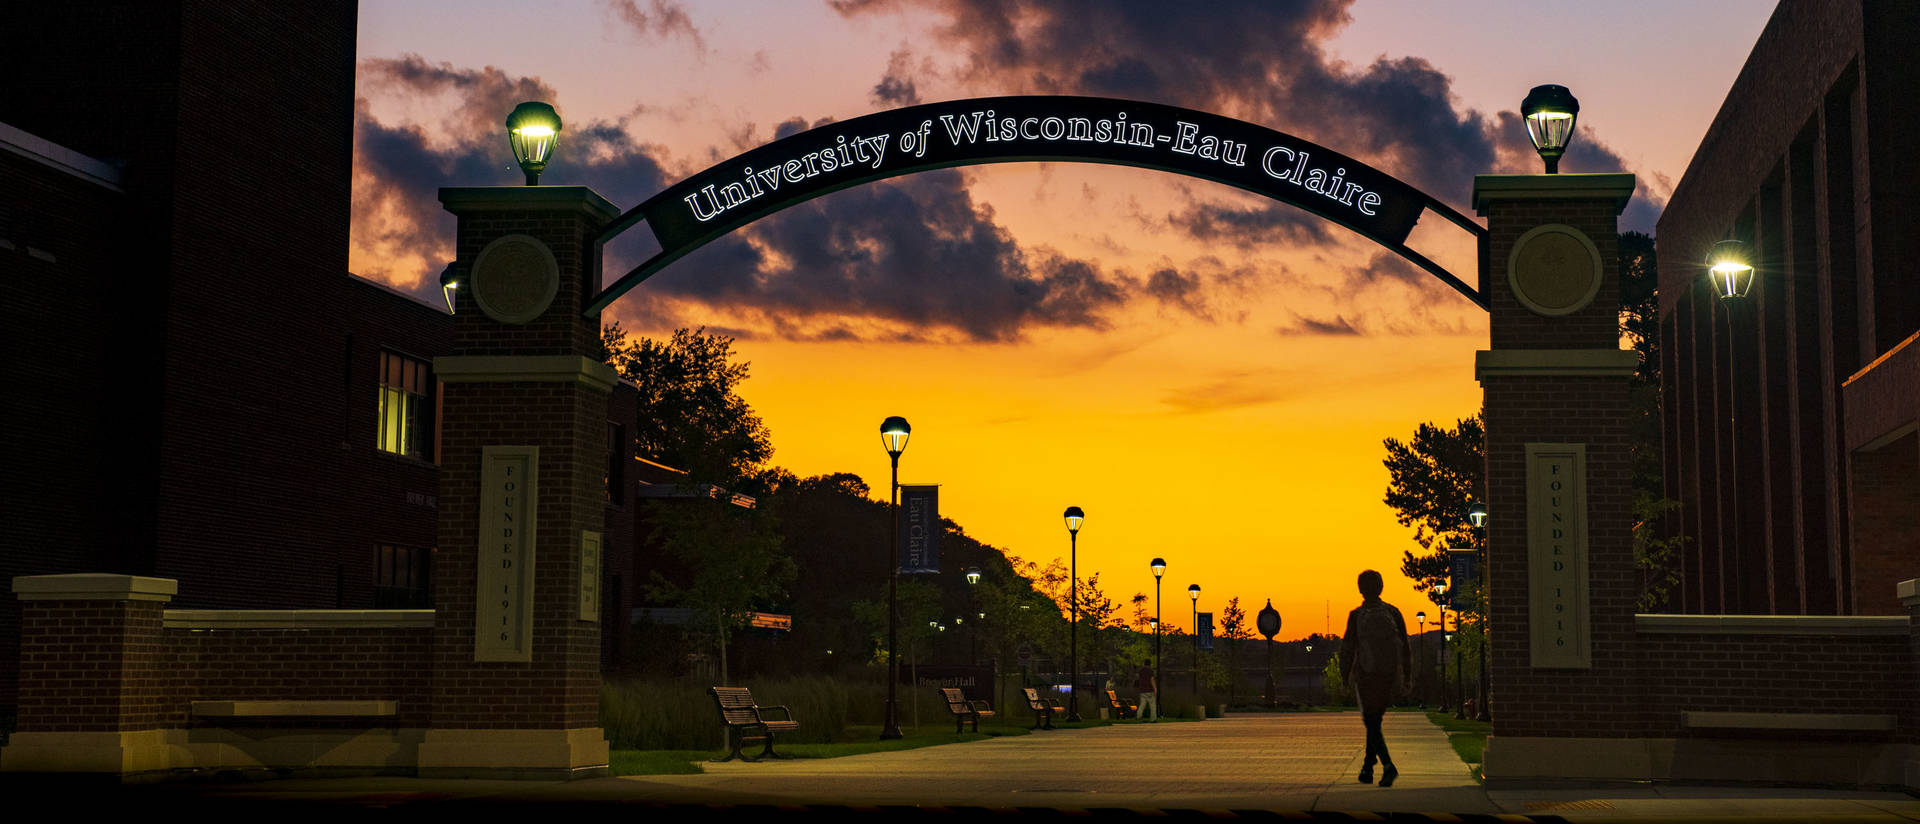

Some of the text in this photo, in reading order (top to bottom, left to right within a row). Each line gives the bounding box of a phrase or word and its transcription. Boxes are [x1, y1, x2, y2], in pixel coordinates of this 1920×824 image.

[685, 109, 1382, 222] University of Wisconsin-Eau Claire
[500, 466, 514, 641] FOUNDED 1916
[910, 496, 923, 566] Eau Claire
[1551, 464, 1564, 648] FOUNDED 1916
[955, 675, 975, 687] Hall
